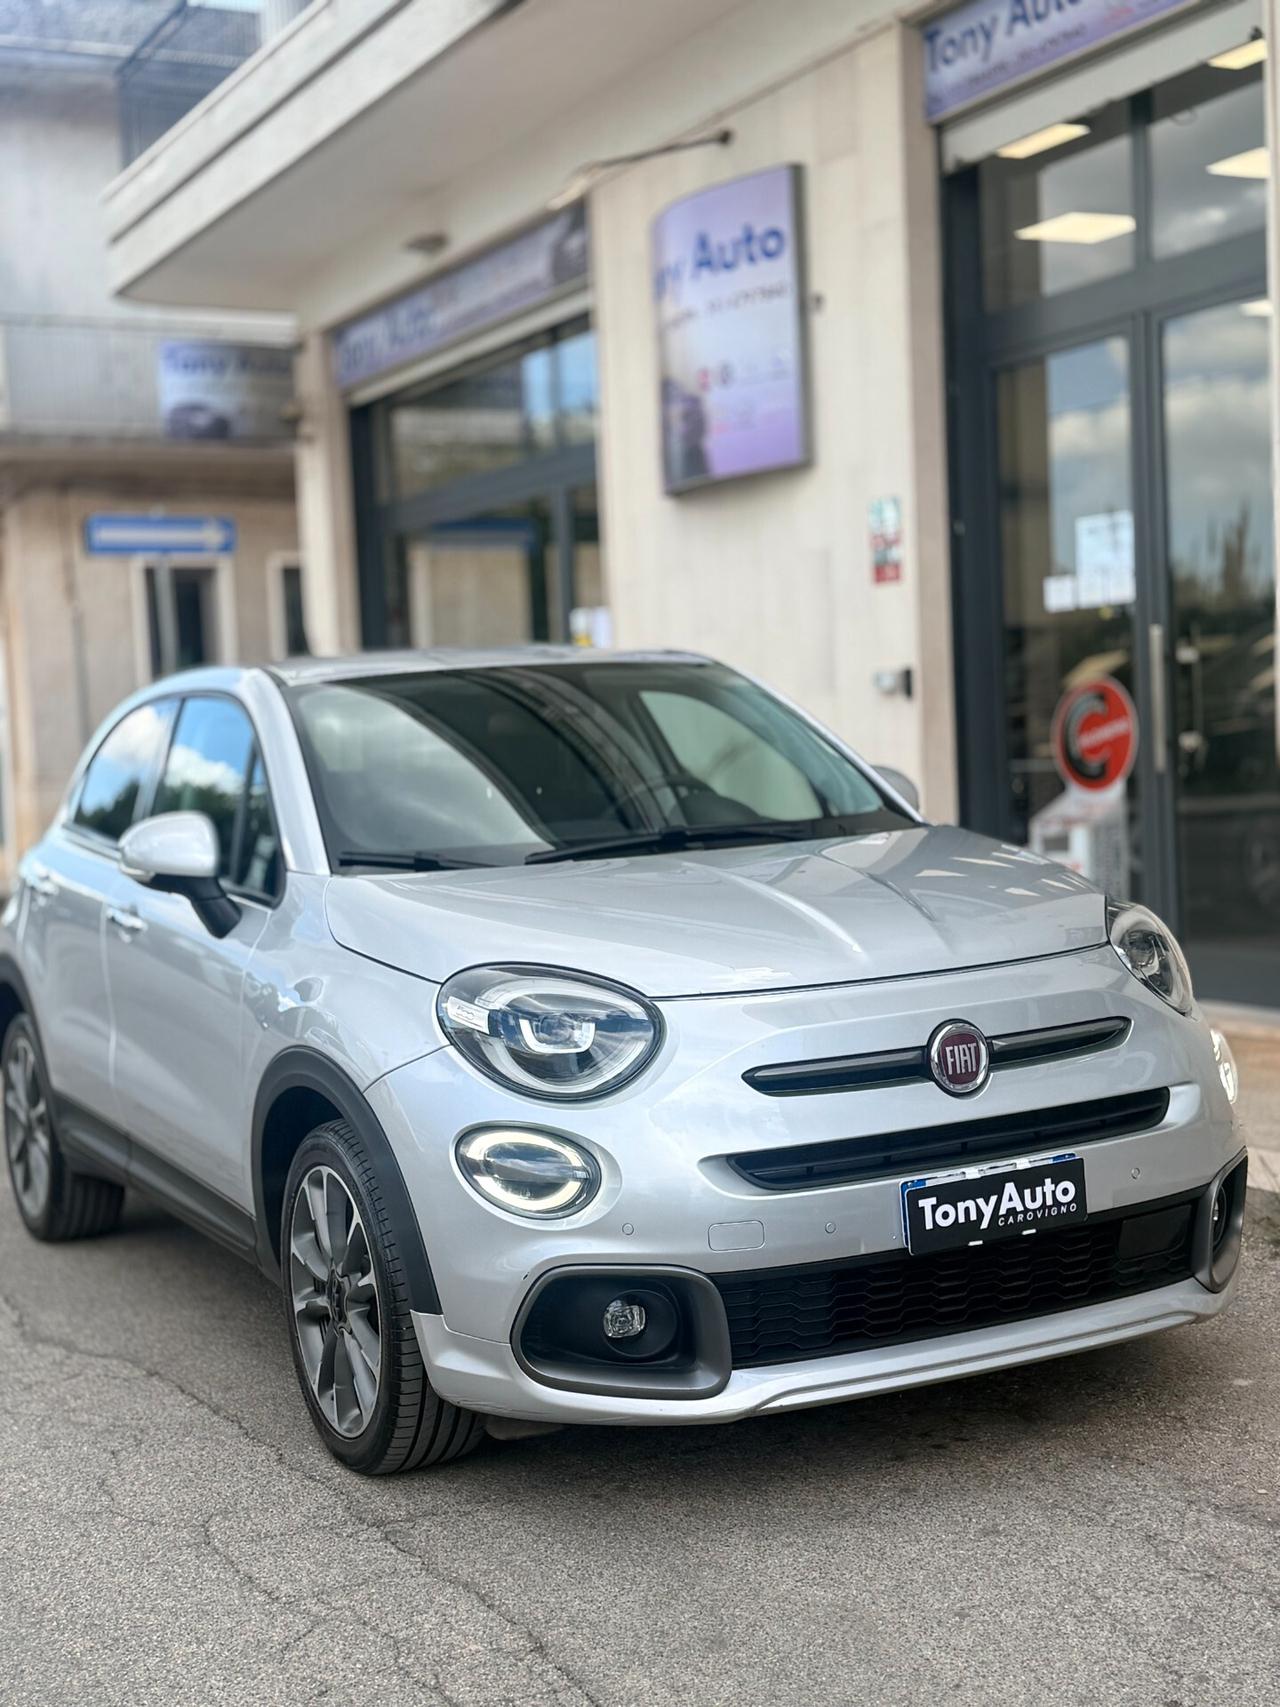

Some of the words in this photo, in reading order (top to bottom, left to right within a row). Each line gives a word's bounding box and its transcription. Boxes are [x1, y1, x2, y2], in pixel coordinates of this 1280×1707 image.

[925, 14, 998, 74] Tony
[1005, 0, 1081, 37] Au
[691, 222, 785, 281] Auto
[945, 1042, 977, 1075] FIAT
[918, 1177, 1076, 1230] TonyAuto
[998, 1202, 1077, 1226] CAROVIGNO
